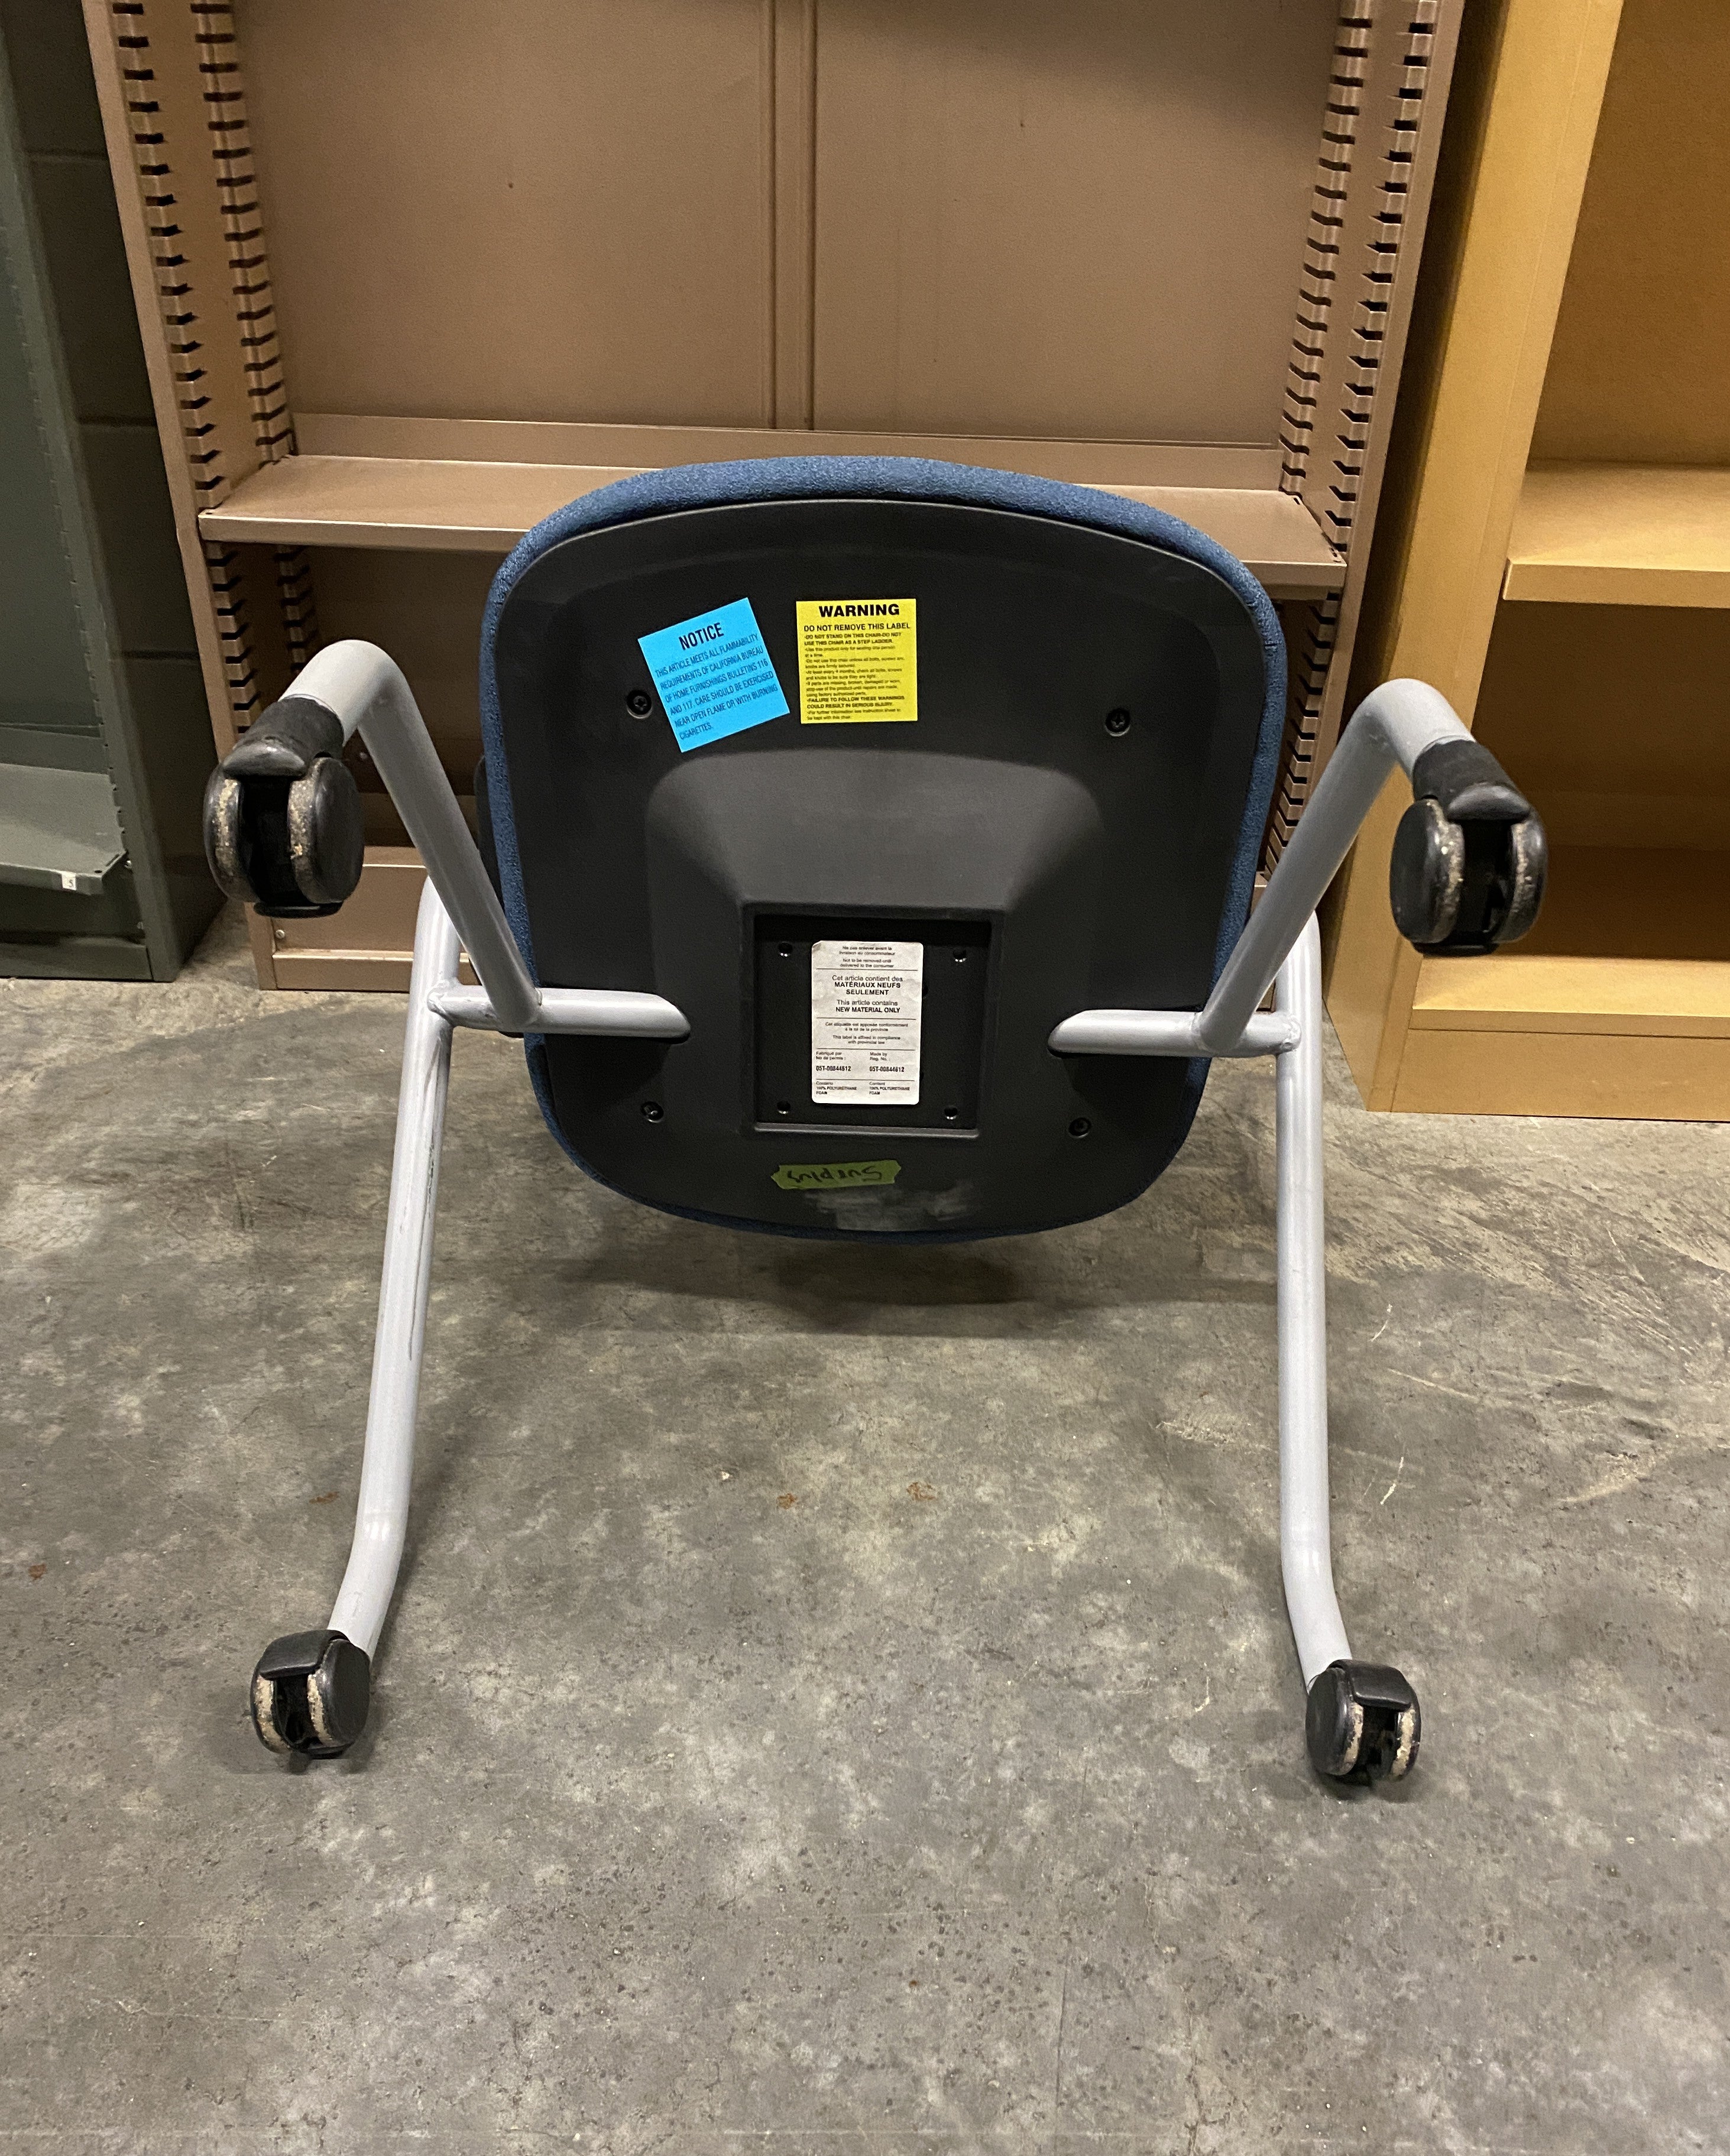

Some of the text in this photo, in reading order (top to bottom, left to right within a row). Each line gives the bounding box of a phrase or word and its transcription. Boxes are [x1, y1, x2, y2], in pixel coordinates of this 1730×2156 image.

[819, 604, 899, 617] WARNING
[679, 622, 724, 650] NOTICE
[655, 667, 668, 677] THIS
[668, 659, 690, 673] ARTICLE
[690, 651, 708, 664] MEETS
[709, 648, 719, 657] ALL
[701, 666, 710, 675] OF
[710, 654, 741, 672] CALIFORNIA
[741, 646, 763, 660] BUREAU
[665, 694, 673, 702] OF
[673, 688, 689, 699] HOME
[727, 663, 757, 679] BULLETINS
[757, 659, 768, 668] 116
[670, 705, 682, 715] AND
[695, 695, 710, 705] CARE
[711, 686, 734, 699] SHOULD
[743, 671, 773, 688] EXERCISED
[675, 684, 777, 727] NEAR OPEN FLAME OR WITH BURNING
[787, 1165, 882, 1183] Surplus
